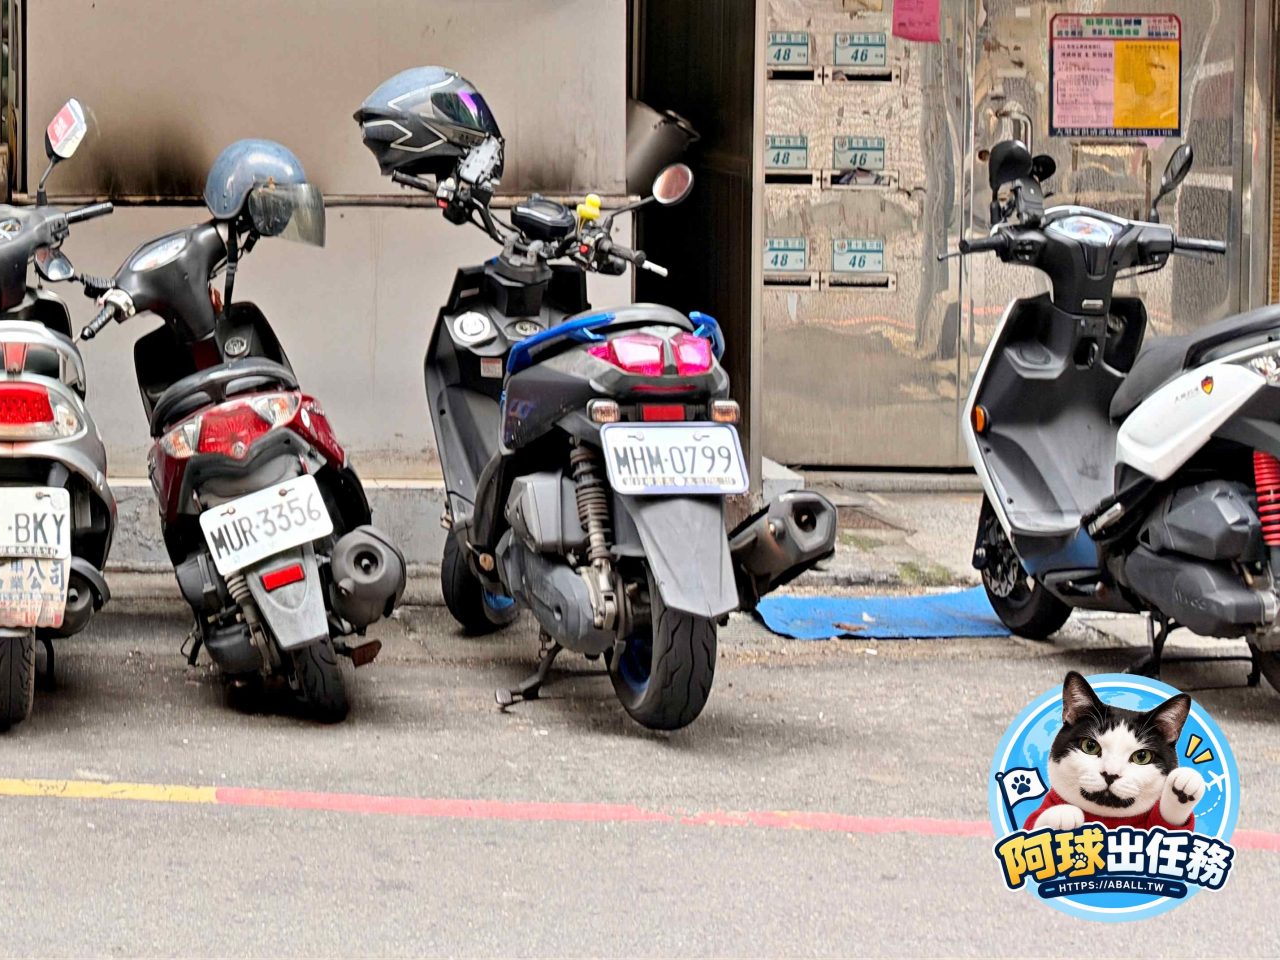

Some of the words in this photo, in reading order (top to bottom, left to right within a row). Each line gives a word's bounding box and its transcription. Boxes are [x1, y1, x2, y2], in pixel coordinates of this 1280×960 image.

[773, 48, 791, 62] 48
[851, 48, 869, 62] 46
[772, 151, 790, 165] 48
[849, 152, 868, 166] 46
[770, 253, 789, 267] 48
[848, 255, 866, 268] 46
